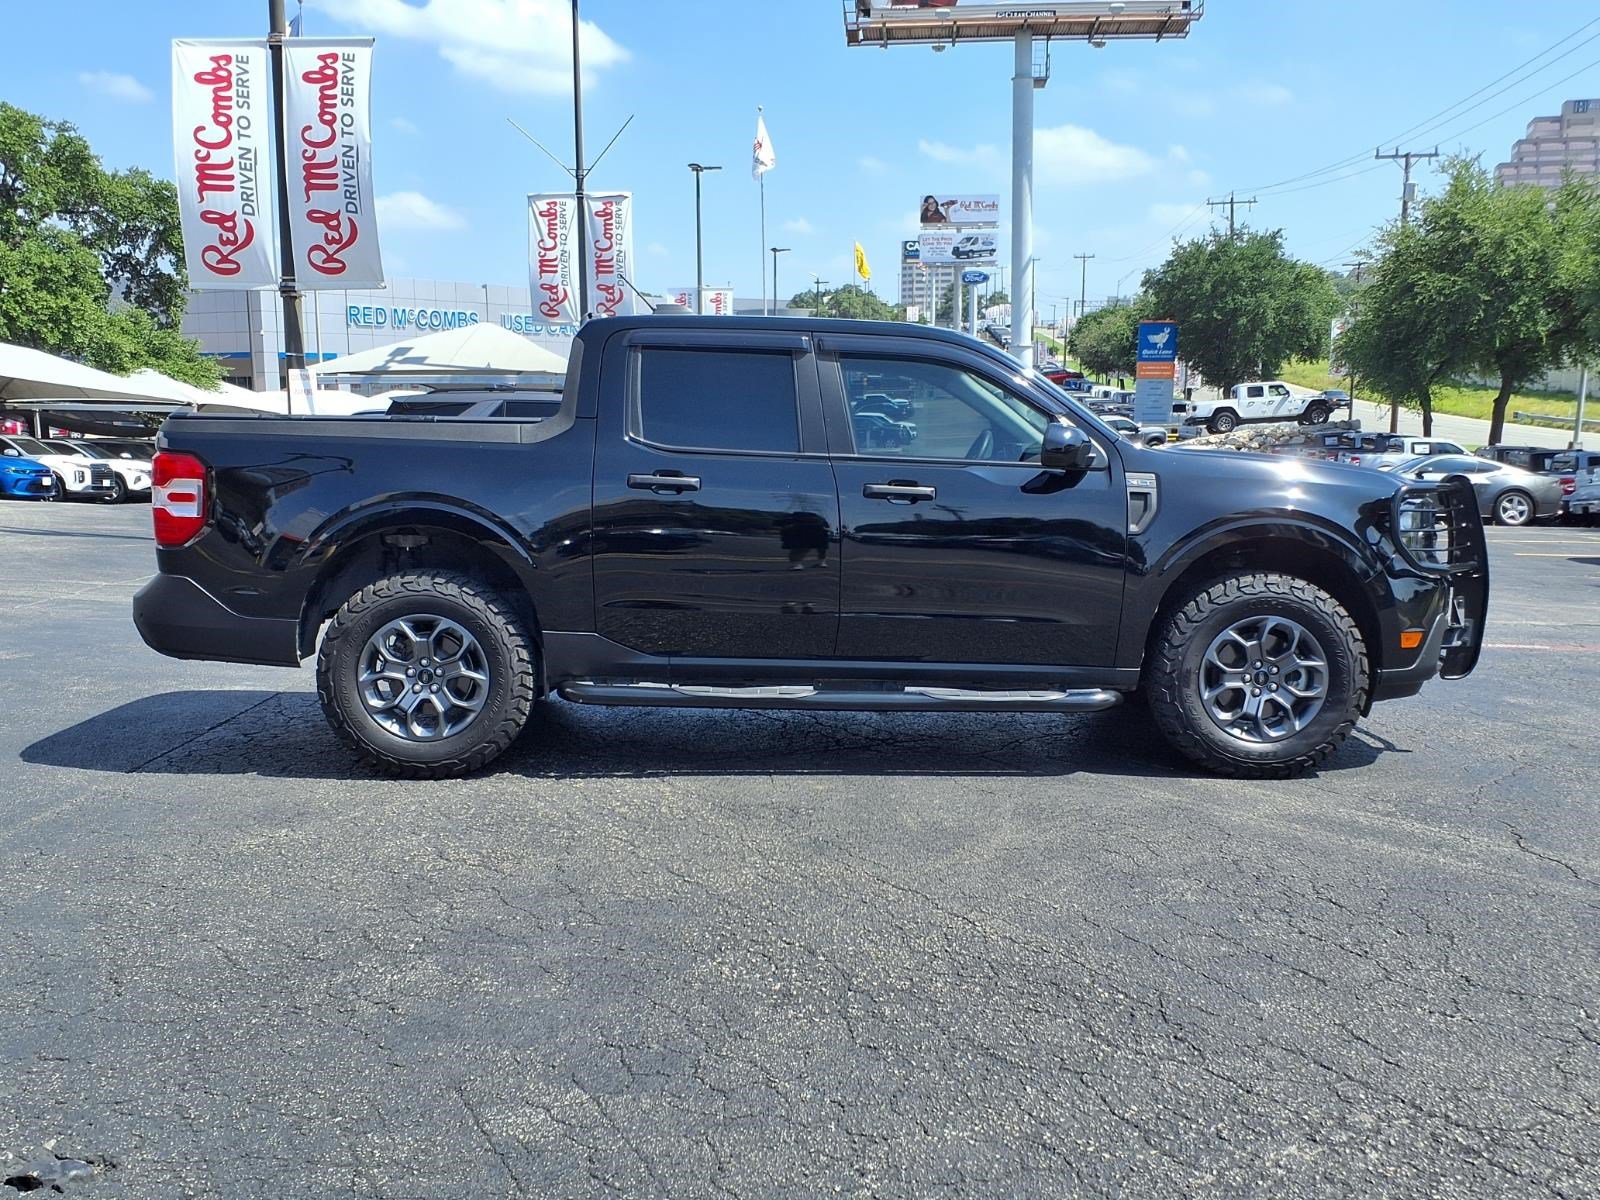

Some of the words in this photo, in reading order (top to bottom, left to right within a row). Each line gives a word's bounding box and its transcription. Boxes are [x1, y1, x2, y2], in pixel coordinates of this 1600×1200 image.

[235, 54, 250, 111] SERVE
[340, 52, 355, 108] SERVE
[193, 54, 235, 204] McCombs
[236, 115, 251, 141] TO
[300, 52, 339, 204] McCombs
[340, 112, 355, 138] TO
[237, 147, 255, 217] DRIVEN
[341, 144, 358, 215] DRIVEN
[559, 201, 567, 231] SERVE
[615, 201, 623, 229] SERVE
[200, 209, 254, 276] Red
[306, 209, 358, 276] Red
[537, 200, 558, 280] McCombs
[559, 233, 567, 246] TO
[594, 200, 614, 280] McCombs
[615, 233, 623, 246] TO
[560, 250, 568, 287] DRIVEN
[615, 250, 624, 287] DRIVEN
[964, 273, 984, 282] Ford
[349, 305, 387, 326] RED
[538, 283, 568, 318] Red
[596, 283, 624, 317] Red
